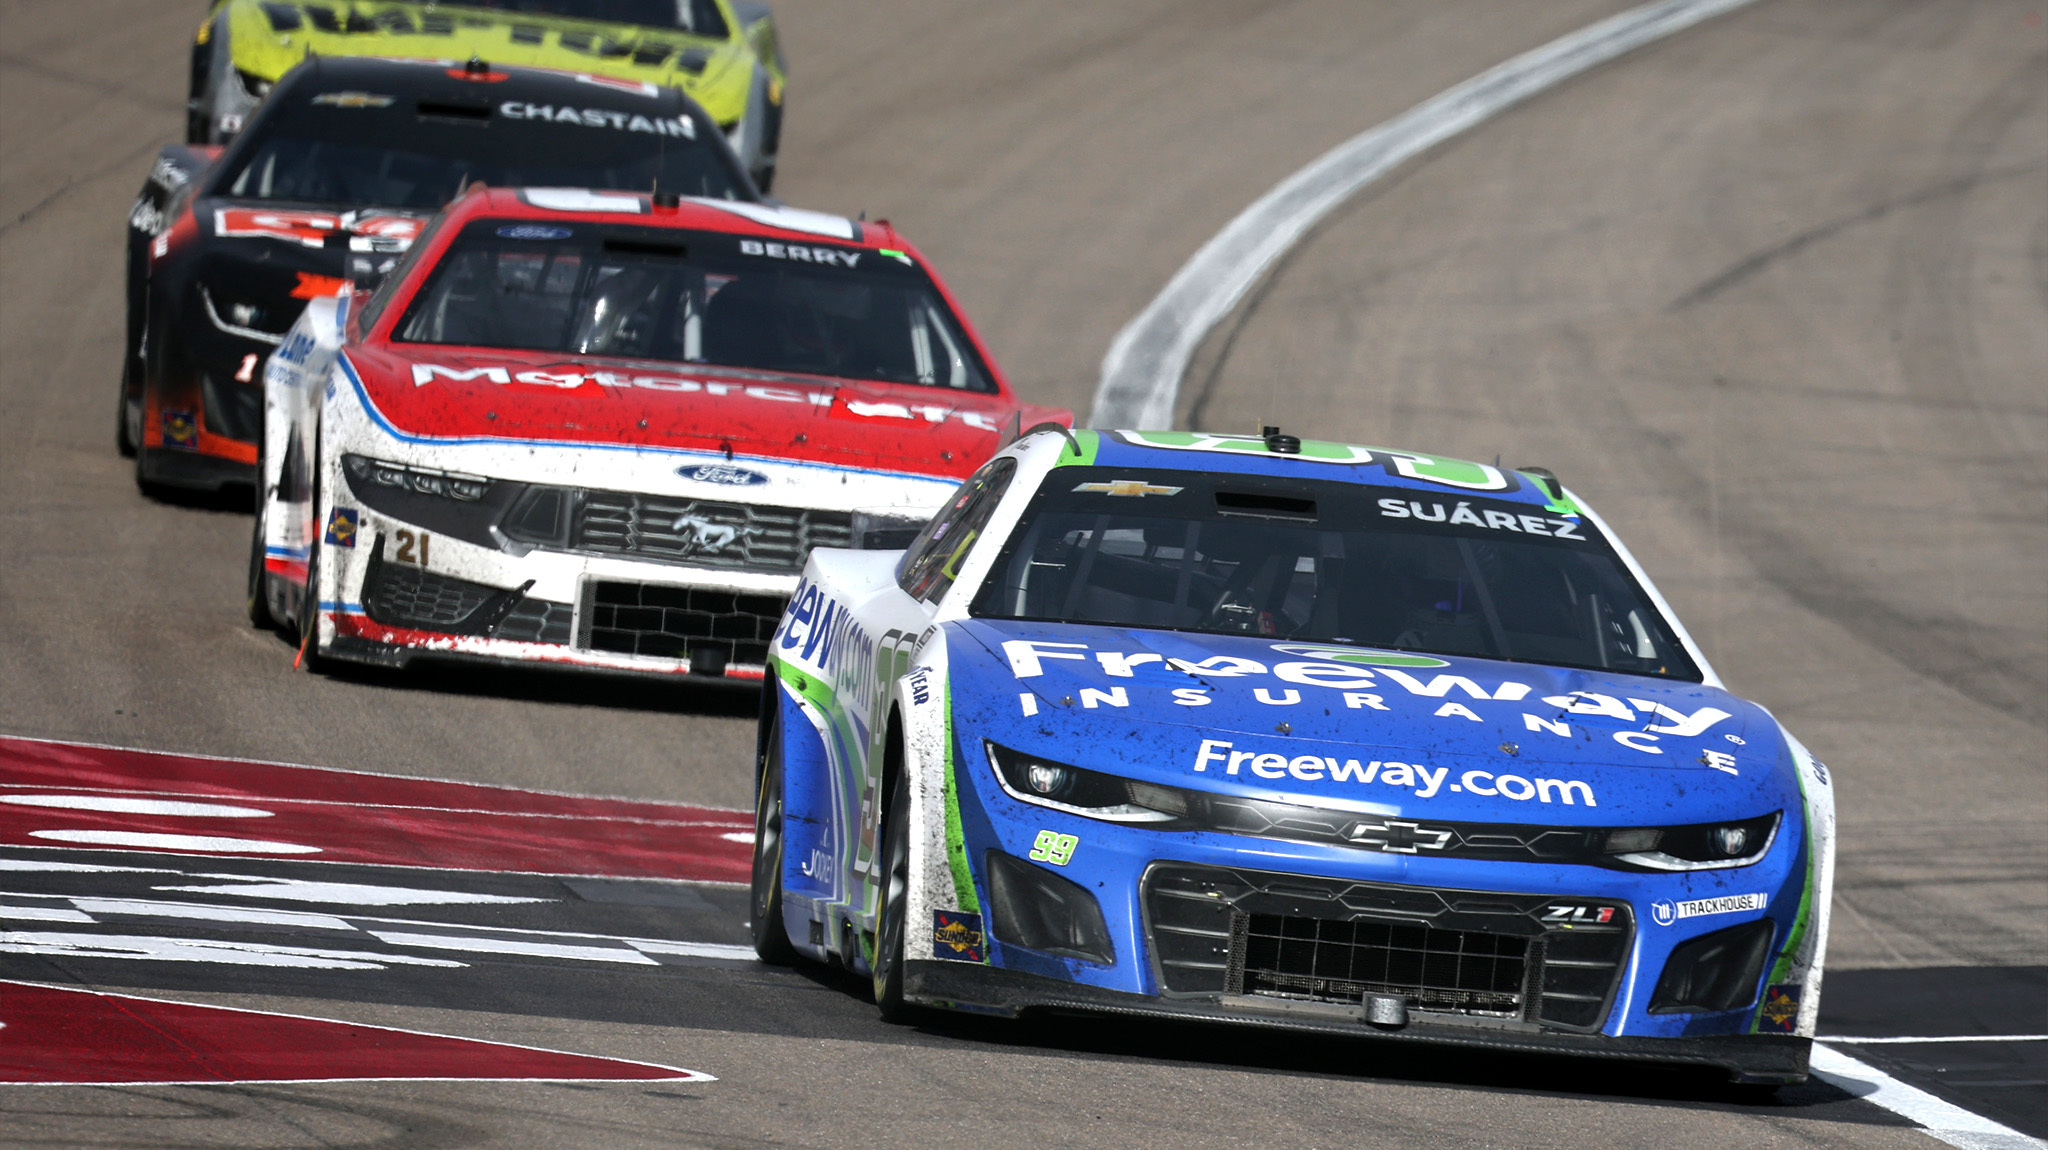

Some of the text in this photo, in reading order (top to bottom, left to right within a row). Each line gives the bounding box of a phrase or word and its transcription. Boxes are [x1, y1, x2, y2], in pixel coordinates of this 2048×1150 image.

[500, 102, 696, 140] CHASTAIN
[740, 240, 861, 268] BERRY
[234, 352, 258, 383] 1
[692, 464, 752, 484] Ford
[1377, 498, 1587, 542] SUÁREZ
[396, 528, 430, 566] 21
[1001, 639, 1733, 738] Freeway
[1193, 739, 1598, 807] Freeway.com
[1028, 829, 1079, 866] 99
[1541, 905, 1615, 923] ZL1
[1682, 895, 1755, 917] TRACKHOUSE
